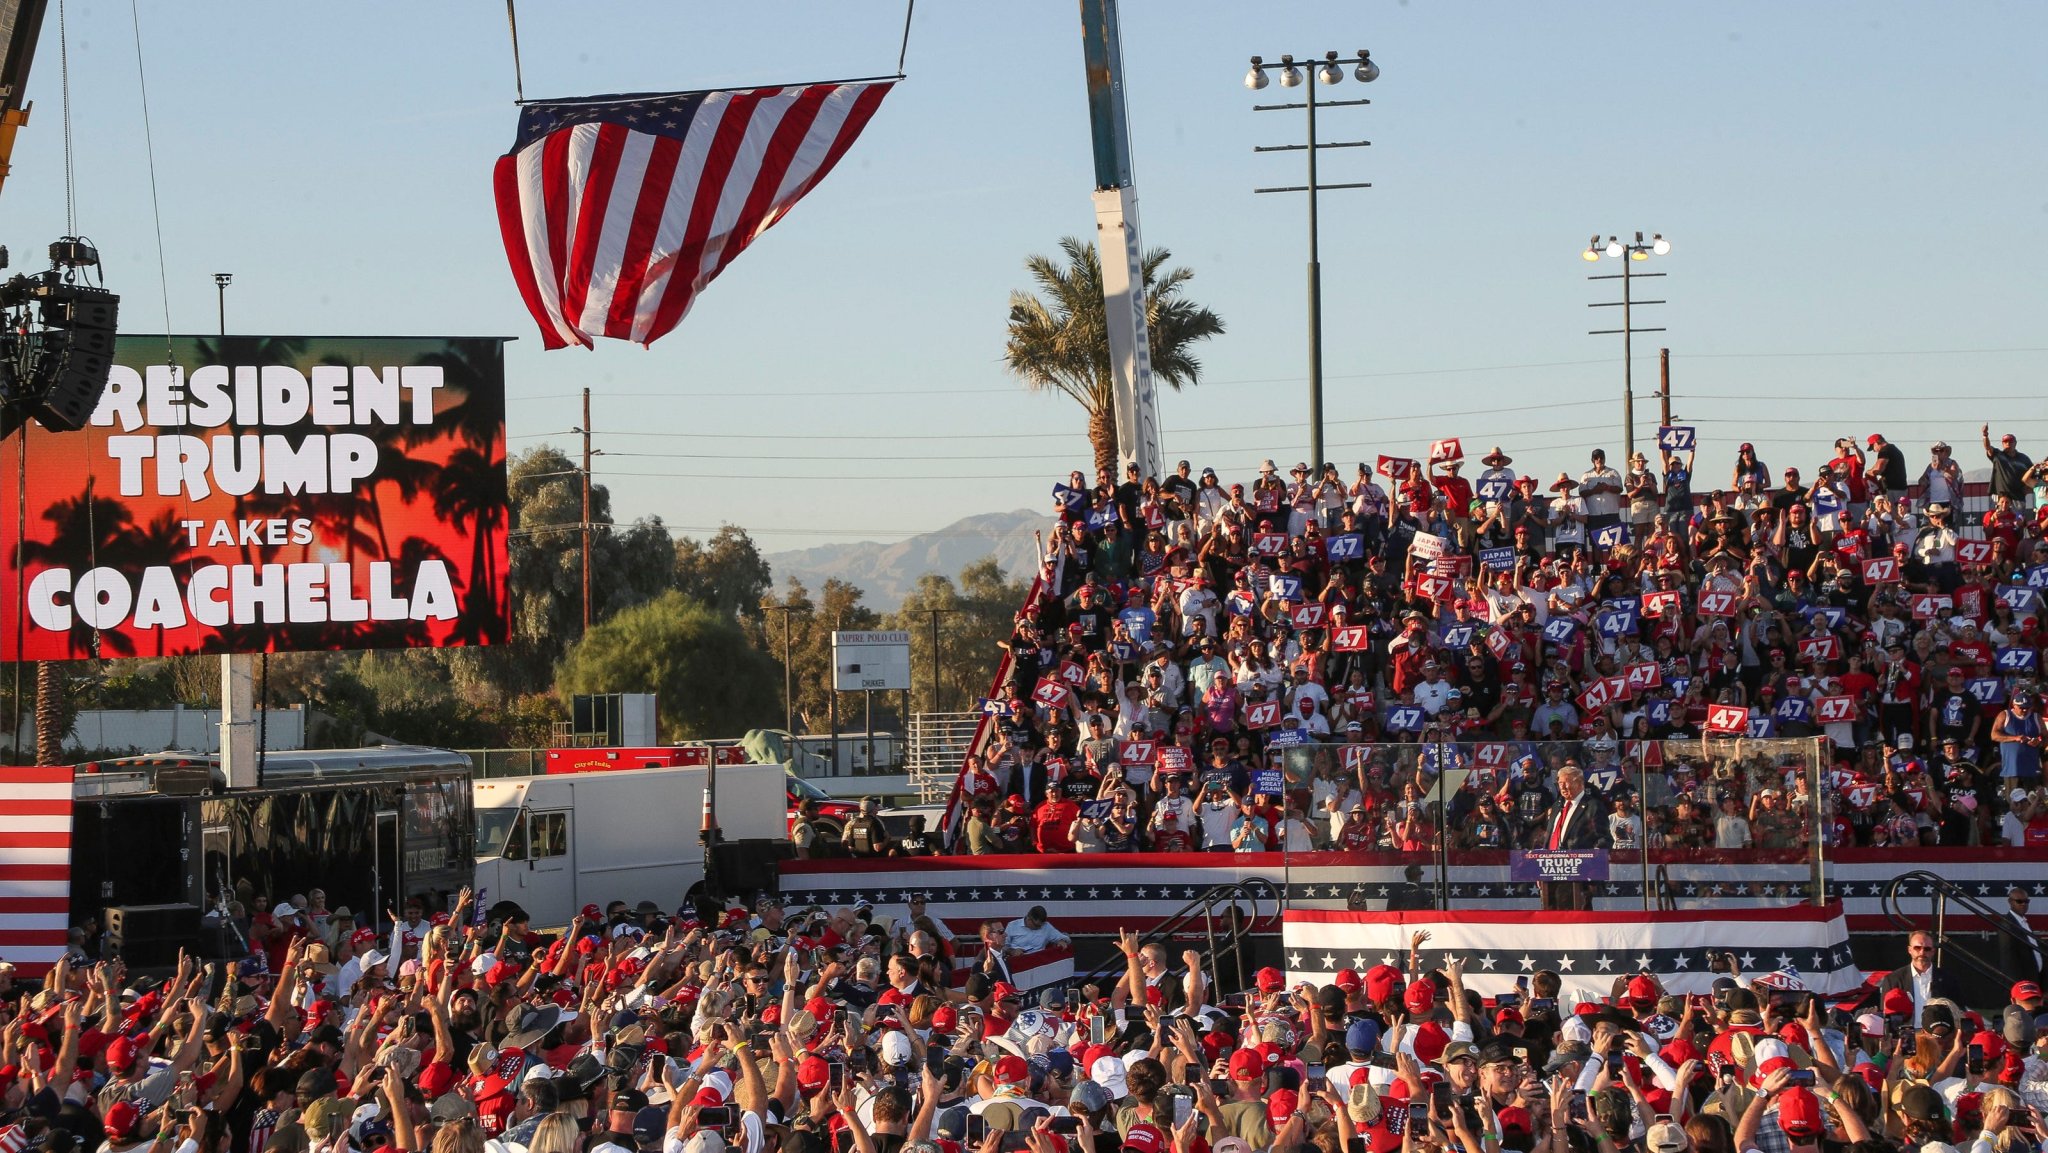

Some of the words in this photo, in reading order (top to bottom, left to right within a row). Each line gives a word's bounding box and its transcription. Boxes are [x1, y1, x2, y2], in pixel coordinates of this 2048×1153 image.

[88, 365, 444, 433] RESIDENT
[1663, 430, 1691, 448] 47
[1432, 443, 1457, 459] 47
[107, 433, 378, 502] TRUMP
[1381, 460, 1408, 477] 47
[1480, 482, 1507, 499] 47
[181, 518, 314, 547] TAKES
[1599, 527, 1622, 547] 47
[1258, 536, 1284, 553] 47
[1331, 538, 1358, 556] 47
[1417, 537, 1443, 548] JAPAN
[1960, 543, 1990, 561] 47
[1483, 551, 1512, 560] JAPAN
[1489, 560, 1514, 570] RUMP
[1866, 561, 1894, 579] 47
[27, 559, 458, 632] COACHELLA
[1271, 577, 1299, 597] 47
[1420, 577, 1449, 597] 47
[1702, 593, 1732, 612] 47
[2002, 589, 2032, 608] 47
[1295, 606, 1323, 625] 47
[1604, 613, 1631, 633] 47
[838, 632, 864, 643] EMPIRE
[867, 632, 887, 643] POLO
[889, 632, 909, 643] CLUB
[1334, 629, 1363, 647] 47
[1445, 627, 1473, 646] 47
[1546, 620, 1574, 639] 47
[1488, 630, 1507, 651] 47
[1804, 639, 1832, 657] 47
[2001, 651, 2033, 667] 47
[1063, 667, 1085, 684] 47
[1629, 664, 1655, 684] 47
[1037, 685, 1068, 704] 47
[1586, 686, 1608, 711] 47
[1968, 681, 1998, 700] 47
[984, 701, 1006, 714] 47
[1250, 704, 1276, 724] 47
[1778, 700, 1804, 717] 47
[1821, 700, 1851, 719] 47
[1391, 709, 1420, 727] 47
[1711, 709, 1744, 729] 47
[1746, 719, 1770, 738] 47
[1124, 743, 1153, 763] 47
[1478, 745, 1505, 764] 47
[575, 761, 587, 769] City
[1588, 770, 1617, 791] 47
[1848, 788, 1875, 807] 47
[1083, 801, 1112, 818] 47
[902, 837, 925, 849] POLICE
[1536, 858, 1582, 867] TRUMP
